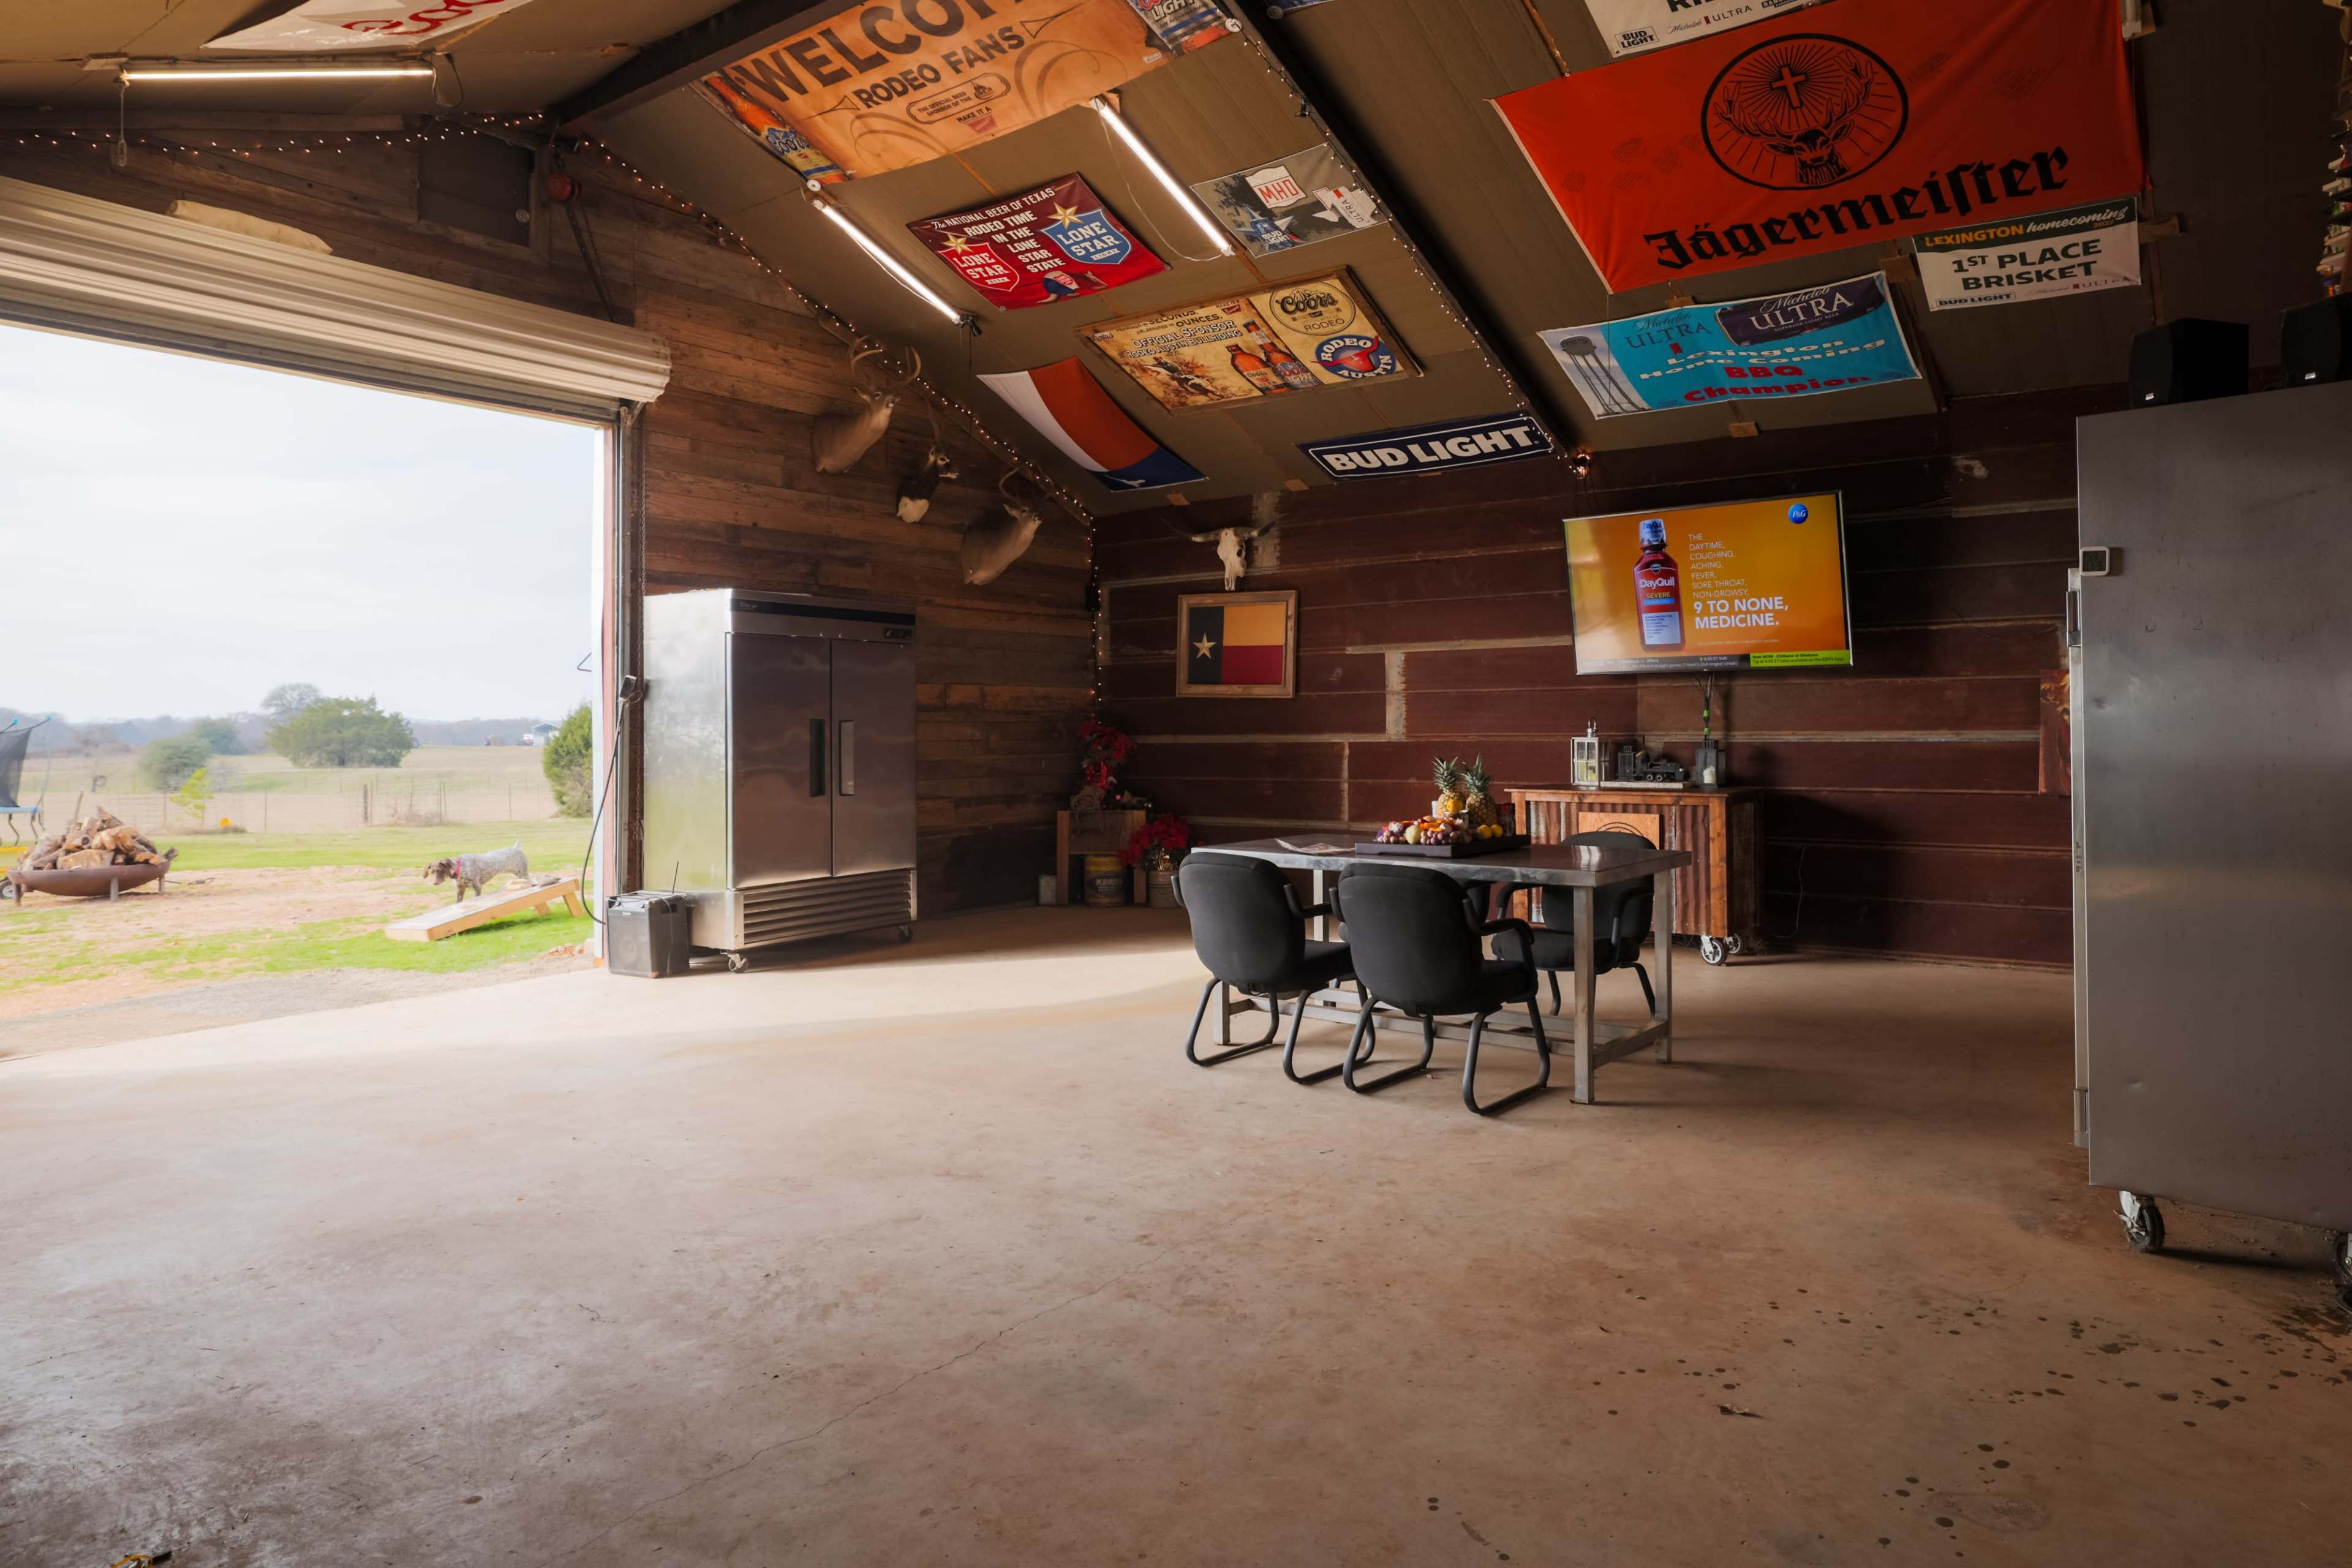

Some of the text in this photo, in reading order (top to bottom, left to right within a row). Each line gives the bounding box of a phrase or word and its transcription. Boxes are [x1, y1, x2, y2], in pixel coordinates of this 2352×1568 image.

[1666, 19, 1702, 35] Michelob
[1712, 5, 1753, 22] ULTRA
[1621, 34, 1654, 48] LIGHT
[1622, 31, 1648, 40] BUD
[731, 0, 997, 102] WELCO
[852, 26, 1024, 109] RODEO FANS
[926, 104, 952, 116] SPONSOR
[929, 98, 953, 109] OFFICIAL
[956, 111, 978, 123] MAKE
[932, 187, 1056, 230] The NATIONAL BEER OF TEXAS
[1342, 199, 1364, 222] ULTRA
[963, 210, 1038, 236] RODEO TIME
[1056, 221, 1108, 245] LONE
[1924, 206, 2129, 246] LEXINGTON homecoming
[991, 227, 1035, 243] IN THE
[1262, 230, 1283, 239] BUD
[1265, 235, 1291, 244] LIGHT
[1007, 238, 1041, 254] LONE
[1017, 249, 1053, 263] STAR
[1071, 235, 1120, 256] STAR
[1951, 238, 2102, 273] 1ST PLACE
[953, 252, 997, 268] LONE
[1026, 258, 1066, 273] STATE
[966, 264, 1011, 279] STAR
[1961, 260, 2097, 291] BRISKET
[1276, 292, 1338, 315] Coors
[1760, 287, 1831, 314] Michelob
[1938, 298, 1969, 306] BUD
[1970, 293, 2013, 303] LIGHT
[1749, 292, 1855, 330] ULTRA
[1131, 319, 1237, 348] OFFICIAL SPONSOR
[1136, 324, 1169, 334] CELEBRATED
[1175, 313, 1223, 328] OUNCES.
[1303, 318, 1345, 331] RODEO
[1126, 329, 1243, 358] RODEO AUSTIN BULLRIDING
[1626, 323, 1713, 349] ULTRA
[1321, 337, 1373, 362] RODEO
[1639, 338, 1887, 380] Home Coming
[1667, 339, 1845, 366] Lexington
[1337, 355, 1392, 379] AUSTIN
[1723, 365, 1804, 379] BBQ
[1321, 426, 1533, 471] BUD LIGHT
[1792, 509, 1806, 518] P&G
[1640, 576, 1675, 589] DayQuil
[1694, 597, 1789, 614] 9 TO NONE,
[1695, 612, 1780, 630] MEDICINE.
